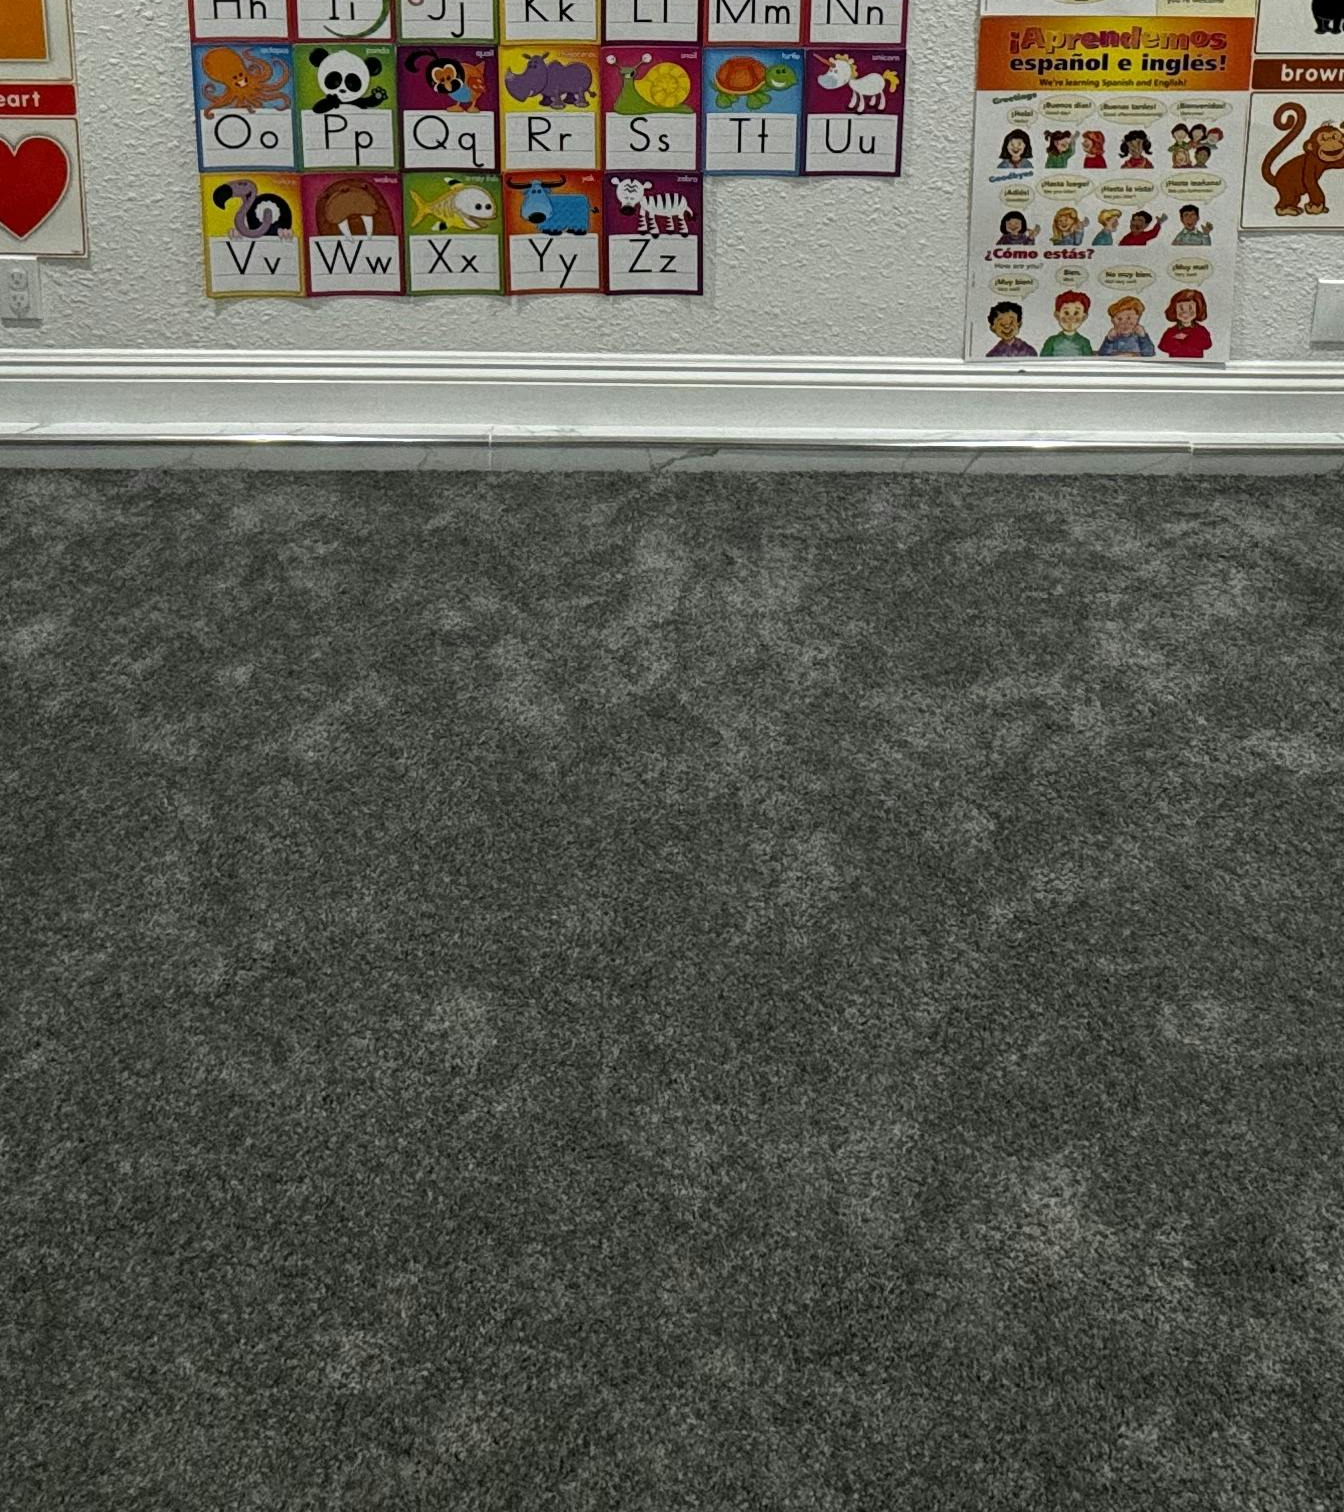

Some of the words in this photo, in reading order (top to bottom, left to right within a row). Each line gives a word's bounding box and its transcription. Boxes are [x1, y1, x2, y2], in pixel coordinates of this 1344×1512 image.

[1009, 26, 1227, 54] ¡Aprendemos
[1009, 53, 1109, 75] español
[1117, 57, 1132, 71] e
[1141, 54, 1227, 76] inglés!
[1039, 78, 1063, 87] We're
[1065, 78, 1100, 88] learning
[1102, 79, 1134, 88] Spanish
[1135, 79, 1152, 87] and
[1154, 79, 1187, 88] English!
[984, 248, 1038, 261] ¿Cómo
[1043, 248, 1095, 260] estás?
